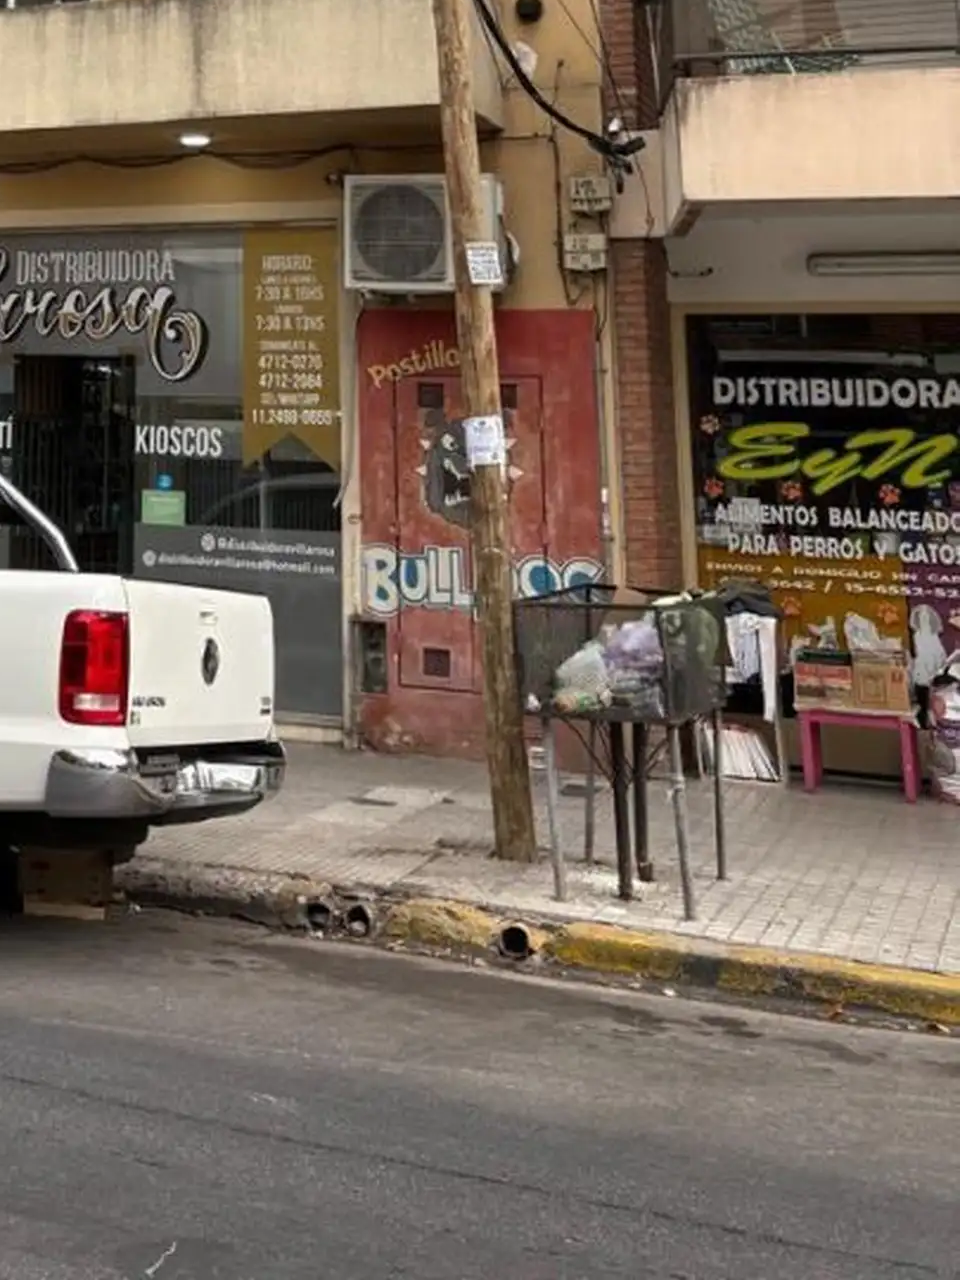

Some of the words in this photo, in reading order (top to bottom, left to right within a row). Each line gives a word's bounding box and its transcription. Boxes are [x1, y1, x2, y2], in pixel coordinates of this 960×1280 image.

[16, 249, 176, 285] DISTRIBUIDORA
[713, 376, 960, 409] DISTRIBUIDORA
[135, 425, 223, 458] KIOSCOS
[728, 534, 781, 556] PARA
[790, 535, 864, 559] PERROS
[873, 539, 888, 562] Y
